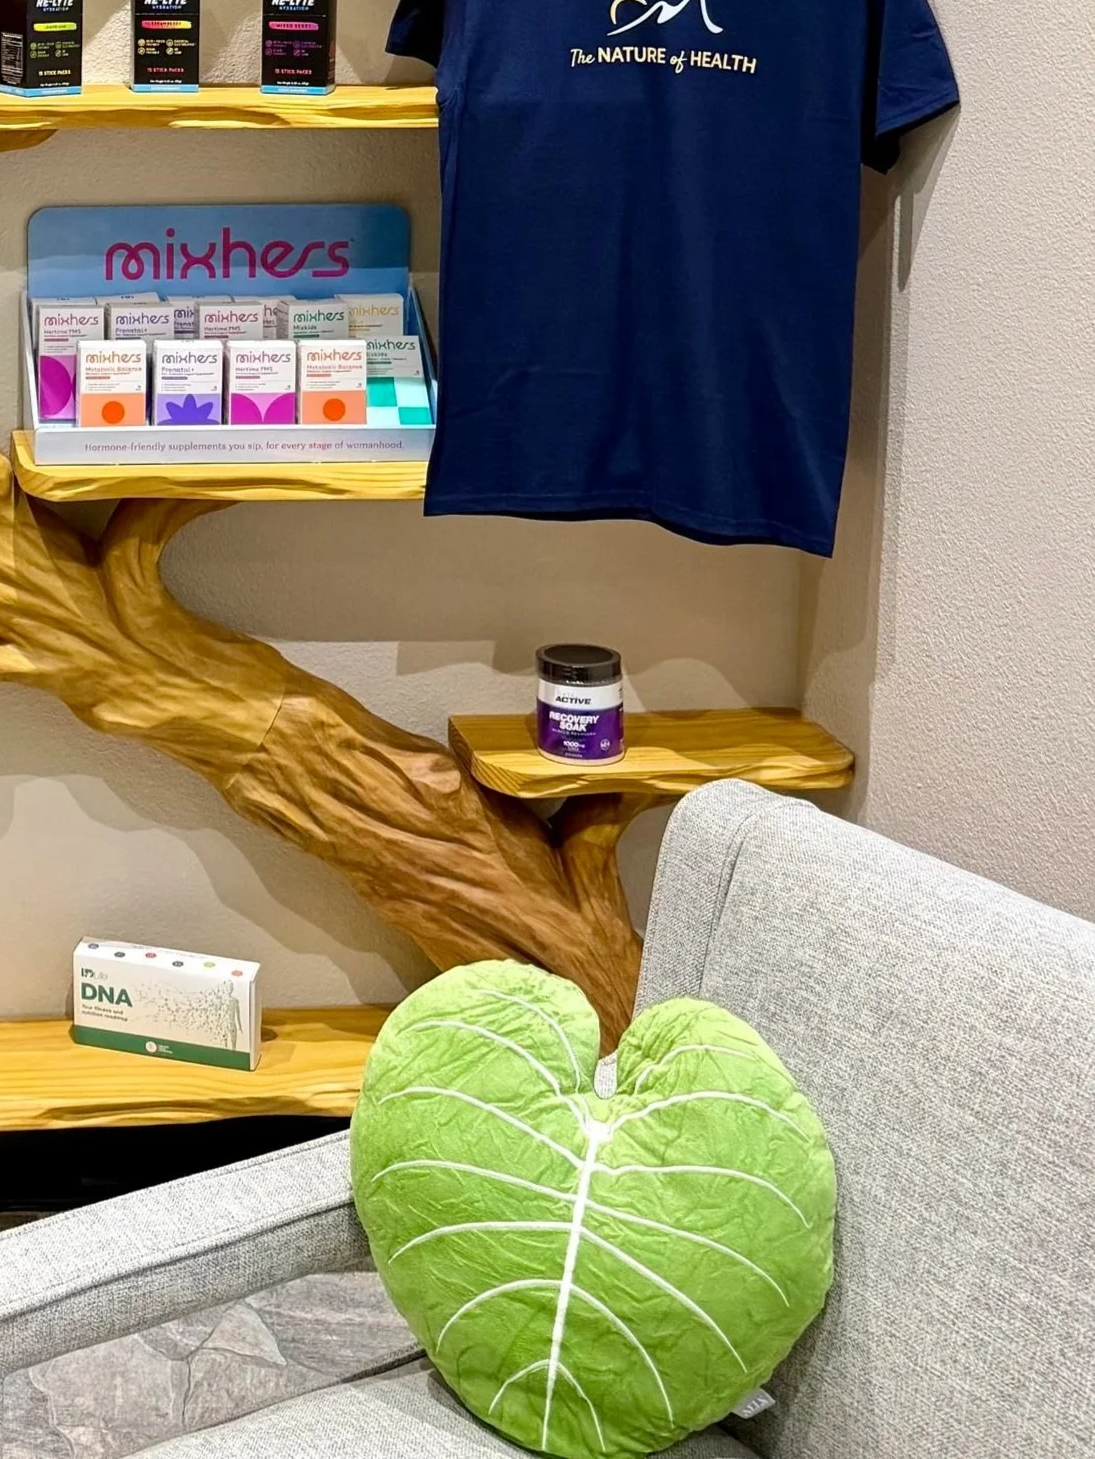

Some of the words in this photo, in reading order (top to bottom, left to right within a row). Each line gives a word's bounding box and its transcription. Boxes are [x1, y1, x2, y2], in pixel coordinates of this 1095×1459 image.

[570, 48, 595, 67] The
[598, 47, 666, 64] NATURE
[670, 51, 687, 74] of
[690, 50, 757, 74] HEALTH
[105, 227, 350, 280] mixhers
[44, 313, 99, 326] mixhers
[115, 311, 170, 325] mixhers
[204, 310, 258, 323] mixhers
[293, 310, 344, 322] mixhers
[86, 351, 141, 363] mixhers
[162, 352, 217, 364] mixhers
[236, 351, 291, 363] mixhers
[307, 349, 362, 361] mixhers
[85, 442, 165, 452] Hormone-friendly
[168, 442, 226, 452] supplements
[247, 441, 263, 451] sip,
[266, 441, 278, 450] for
[281, 443, 305, 451] every
[308, 442, 332, 451] stage
[334, 441, 344, 449] of
[346, 441, 404, 449] womanhood.
[555, 696, 591, 704] ACTIVE
[549, 711, 599, 724] RECOVERY
[559, 721, 587, 731] SOAK
[81, 982, 133, 1008] DNA
